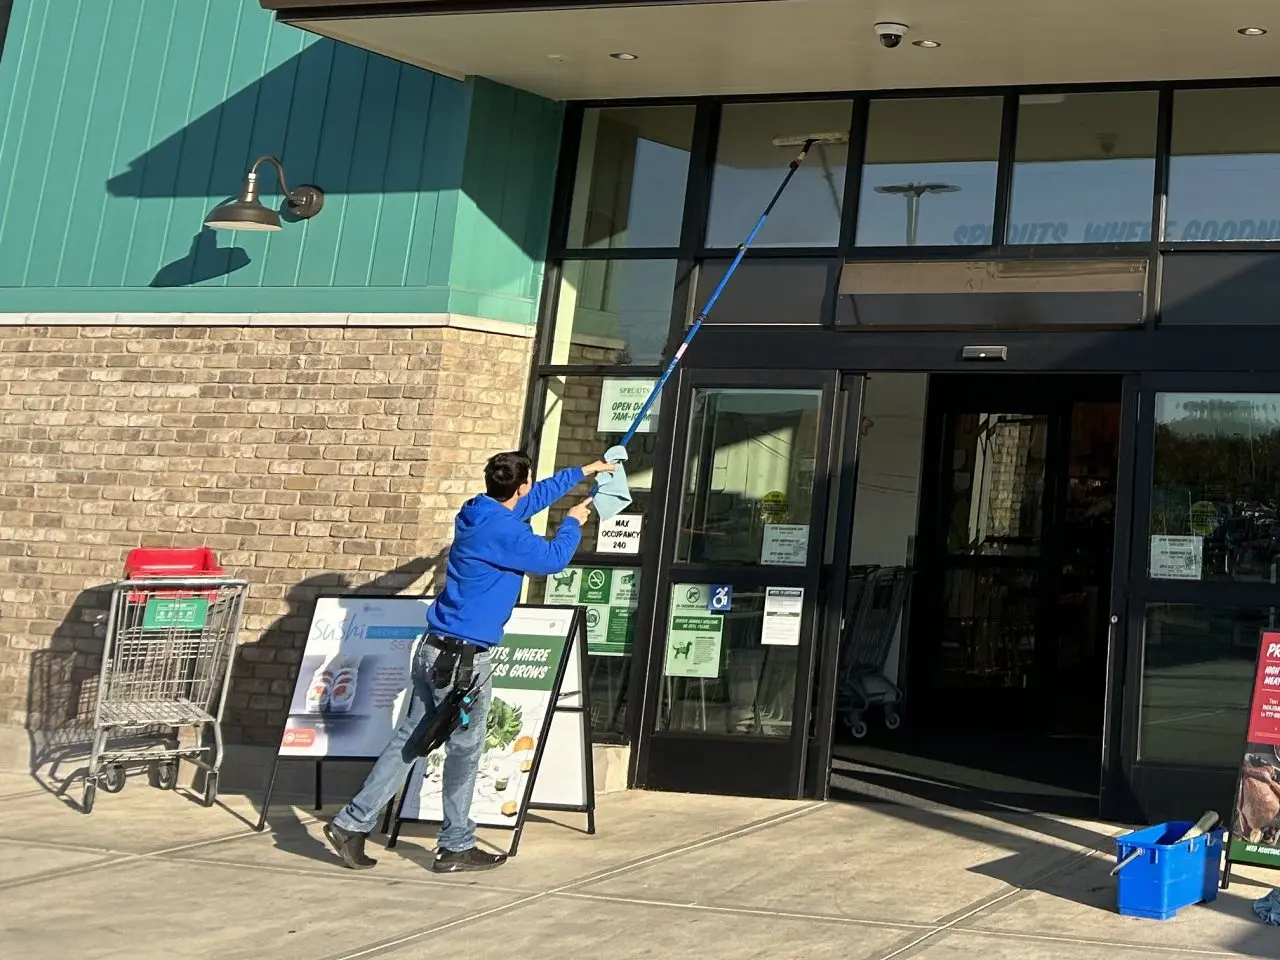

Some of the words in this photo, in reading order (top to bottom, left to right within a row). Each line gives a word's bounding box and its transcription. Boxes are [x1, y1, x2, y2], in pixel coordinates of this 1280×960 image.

[611, 402, 632, 411] OPEN
[601, 530, 640, 538] OCCUPANCY
[612, 541, 626, 549] 240
[512, 648, 552, 662] WHERE
[1264, 666, 1280, 675] HIGH
